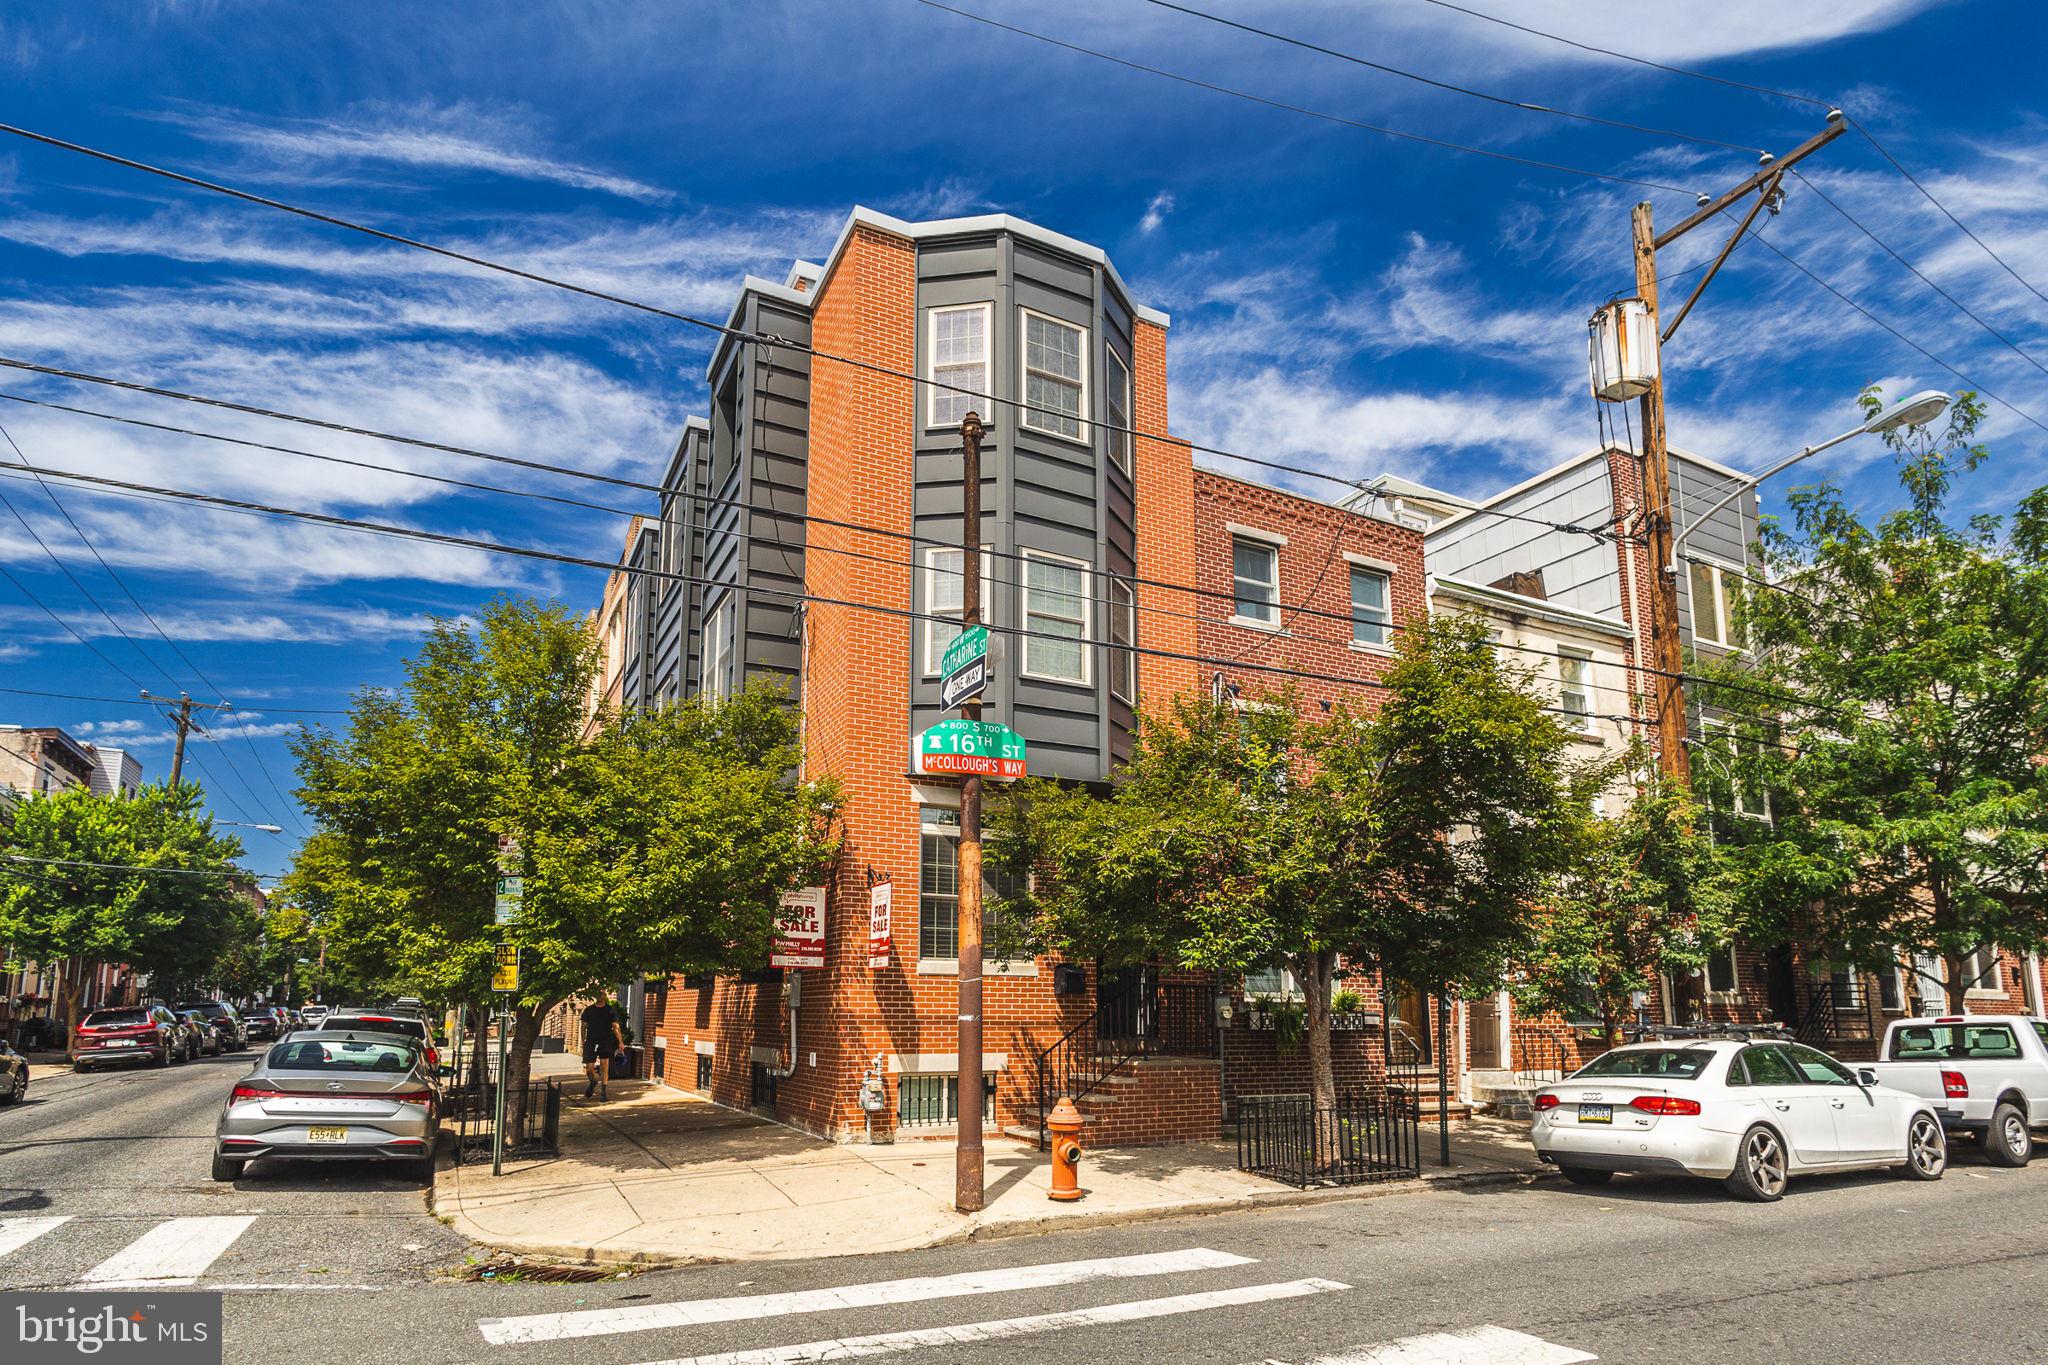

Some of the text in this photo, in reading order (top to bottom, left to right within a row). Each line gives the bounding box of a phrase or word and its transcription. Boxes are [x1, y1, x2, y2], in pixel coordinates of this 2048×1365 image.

[943, 638, 986, 677] CATHARINE ST
[952, 667, 981, 695] ONE WAY
[973, 722, 980, 732] S
[984, 724, 1000, 733] 700
[950, 734, 1021, 759] 16TH ST
[1004, 761, 1023, 775] WAY
[498, 882, 504, 893] 2
[784, 905, 816, 919] FOR
[874, 904, 887, 918] FOR
[780, 919, 819, 933] SALE
[872, 919, 888, 933] SALE
[496, 955, 517, 964] DOWN
